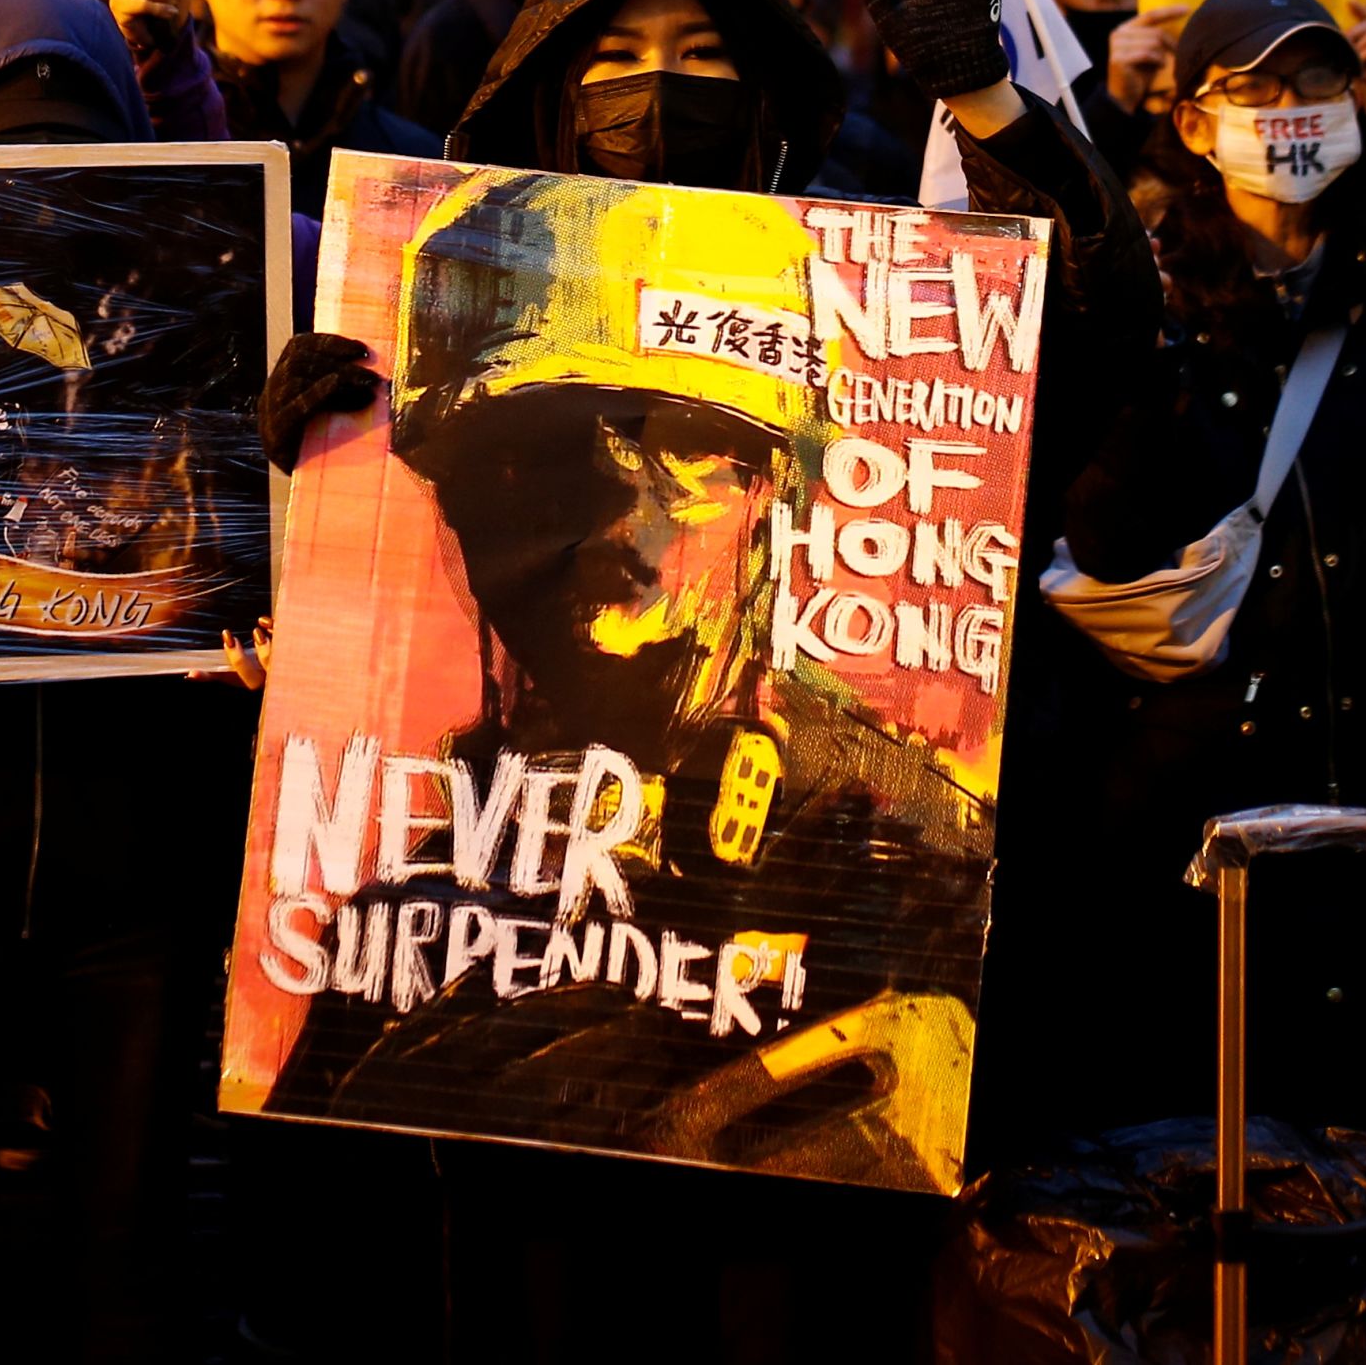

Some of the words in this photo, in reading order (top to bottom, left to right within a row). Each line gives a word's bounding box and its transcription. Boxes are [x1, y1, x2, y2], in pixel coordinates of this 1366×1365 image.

[1253, 114, 1325, 140] FREE
[1266, 142, 1325, 177] HK
[803, 207, 932, 265] THE
[652, 299, 828, 390] 光復香港
[806, 249, 1048, 374] NEW
[826, 370, 1025, 434] GENERATION
[822, 436, 988, 516] OF
[770, 497, 1020, 604] HONG
[40, 586, 153, 630] KONG
[771, 580, 1006, 697] KONG
[271, 728, 645, 928] NEVER
